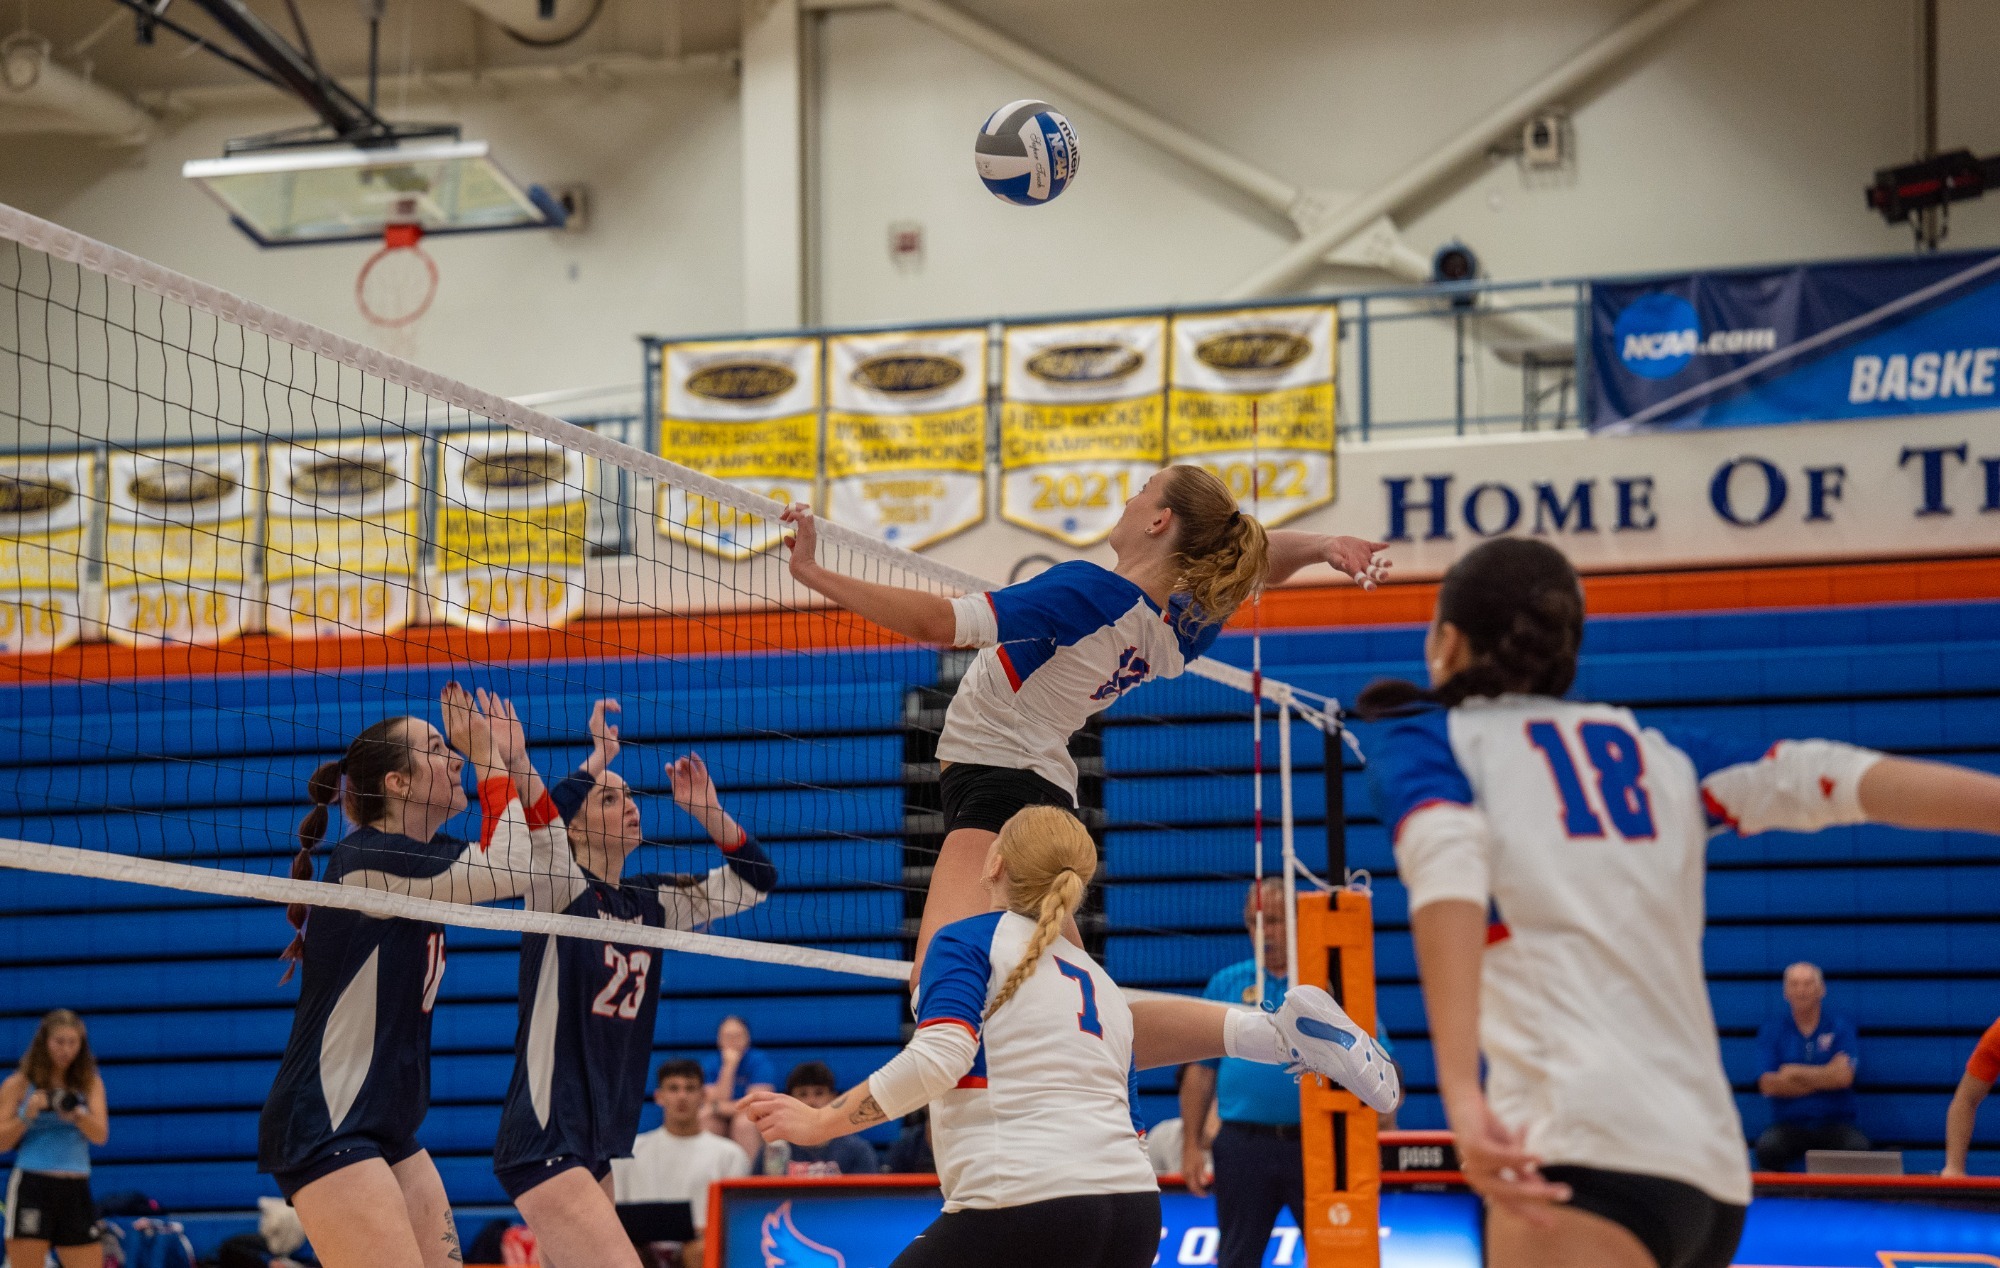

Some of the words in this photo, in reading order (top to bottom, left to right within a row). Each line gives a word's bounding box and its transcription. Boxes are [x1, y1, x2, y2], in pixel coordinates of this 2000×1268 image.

[1046, 131, 1067, 180] NCAA
[1059, 121, 1078, 179] molten
[1849, 347, 2000, 404] BASKE
[1030, 470, 1131, 511] 2021
[1382, 474, 1657, 541] HOME
[1708, 455, 1846, 527] OF
[129, 592, 228, 630] 2018
[291, 584, 391, 625] 2019
[463, 573, 565, 615] 2019
[1523, 717, 1658, 843] 18
[591, 943, 652, 1020] 23
[1053, 954, 1103, 1041] 7
